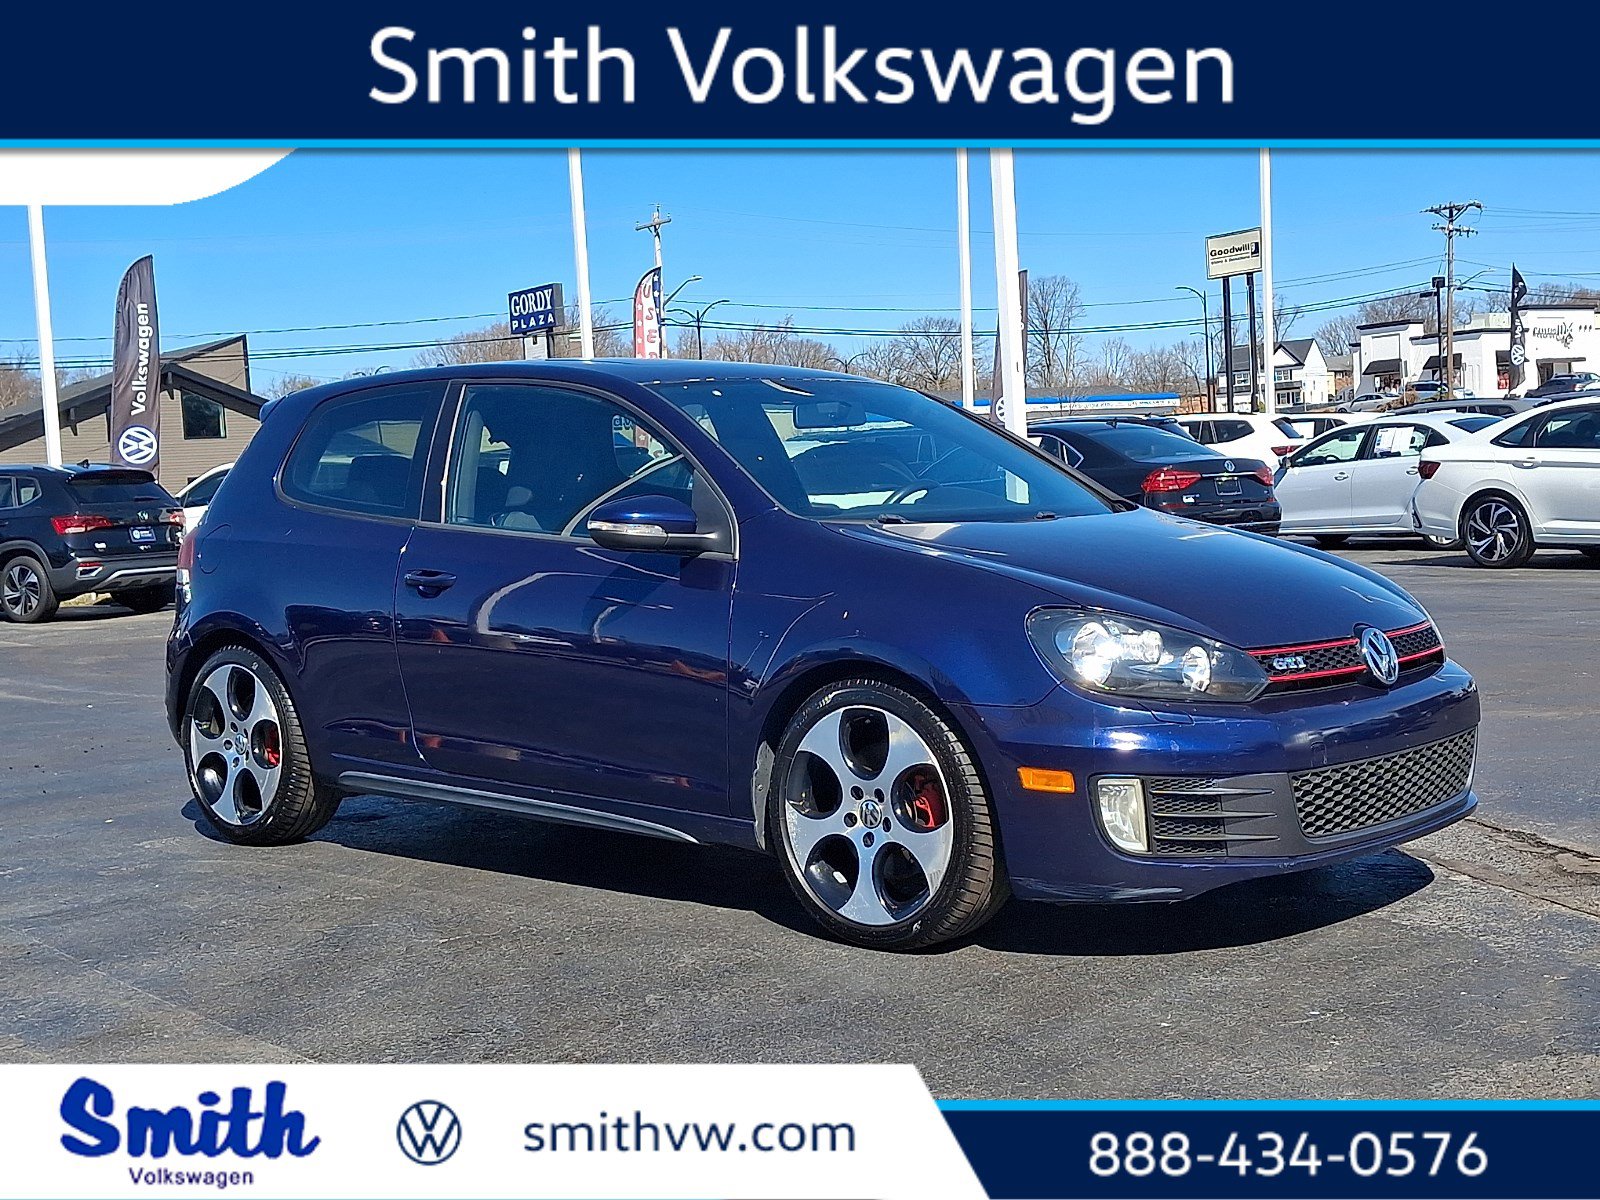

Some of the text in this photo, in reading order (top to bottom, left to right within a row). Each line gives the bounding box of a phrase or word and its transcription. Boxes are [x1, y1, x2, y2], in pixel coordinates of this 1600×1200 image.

[1209, 243, 1250, 257] Goodwill
[510, 288, 553, 317] GORDY
[511, 312, 555, 331] PLAZA
[130, 302, 154, 417] Volkswagen
[1273, 655, 1307, 671] GTI
